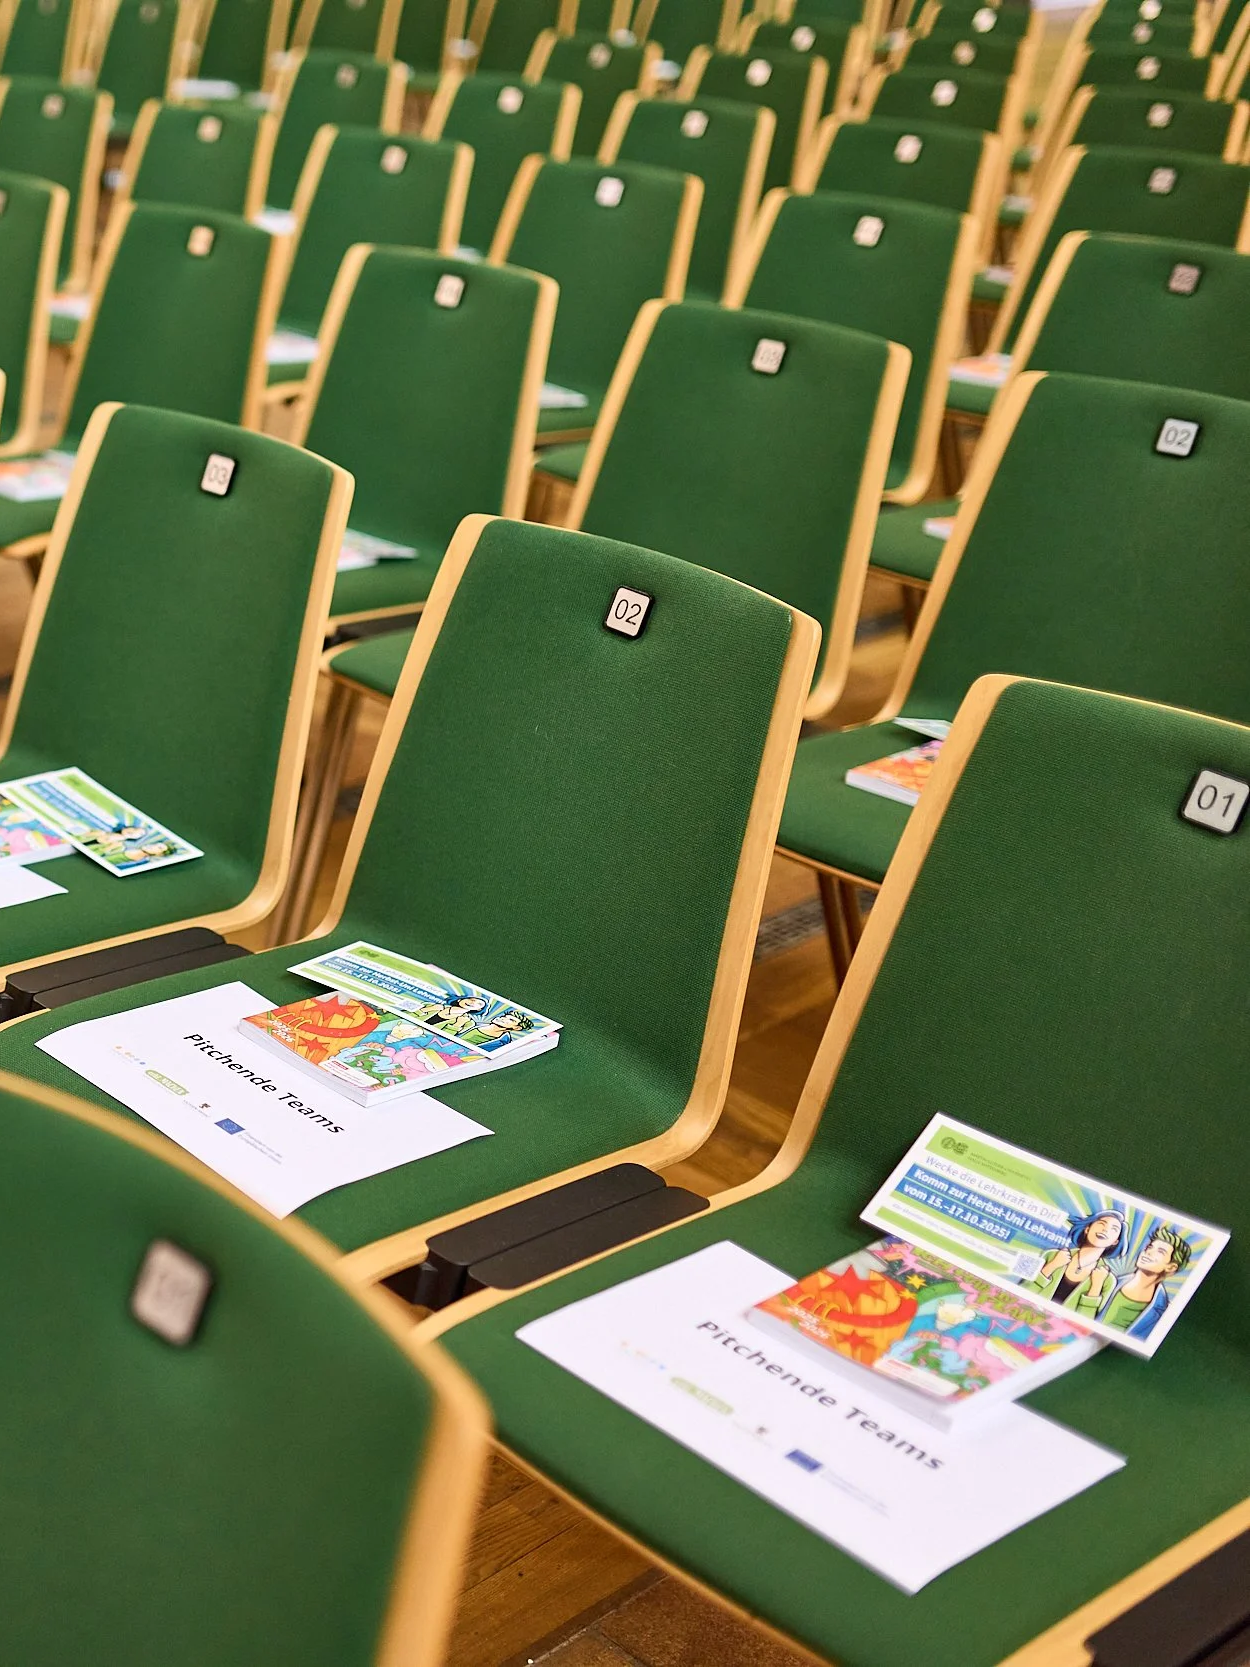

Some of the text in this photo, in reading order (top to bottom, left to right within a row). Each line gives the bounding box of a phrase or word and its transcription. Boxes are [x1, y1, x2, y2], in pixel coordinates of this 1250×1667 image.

[1165, 426, 1191, 448] 02
[615, 599, 641, 626] 02
[1197, 785, 1235, 818] 01
[183, 1033, 277, 1093] Pitchende
[278, 1092, 345, 1134] Teams
[903, 1183, 928, 1201] vom
[926, 1155, 959, 1177] Wecke
[959, 1171, 977, 1186] die
[978, 1179, 1026, 1208] Lehrkraft
[1026, 1199, 1039, 1213] in
[914, 1169, 948, 1193] Komm
[948, 1185, 967, 1201] zur
[967, 1191, 1026, 1226] Herbst-Uni
[1025, 1218, 1072, 1247] Lehramt
[697, 1321, 838, 1408] Pitchende
[845, 1407, 944, 1470] Teams
